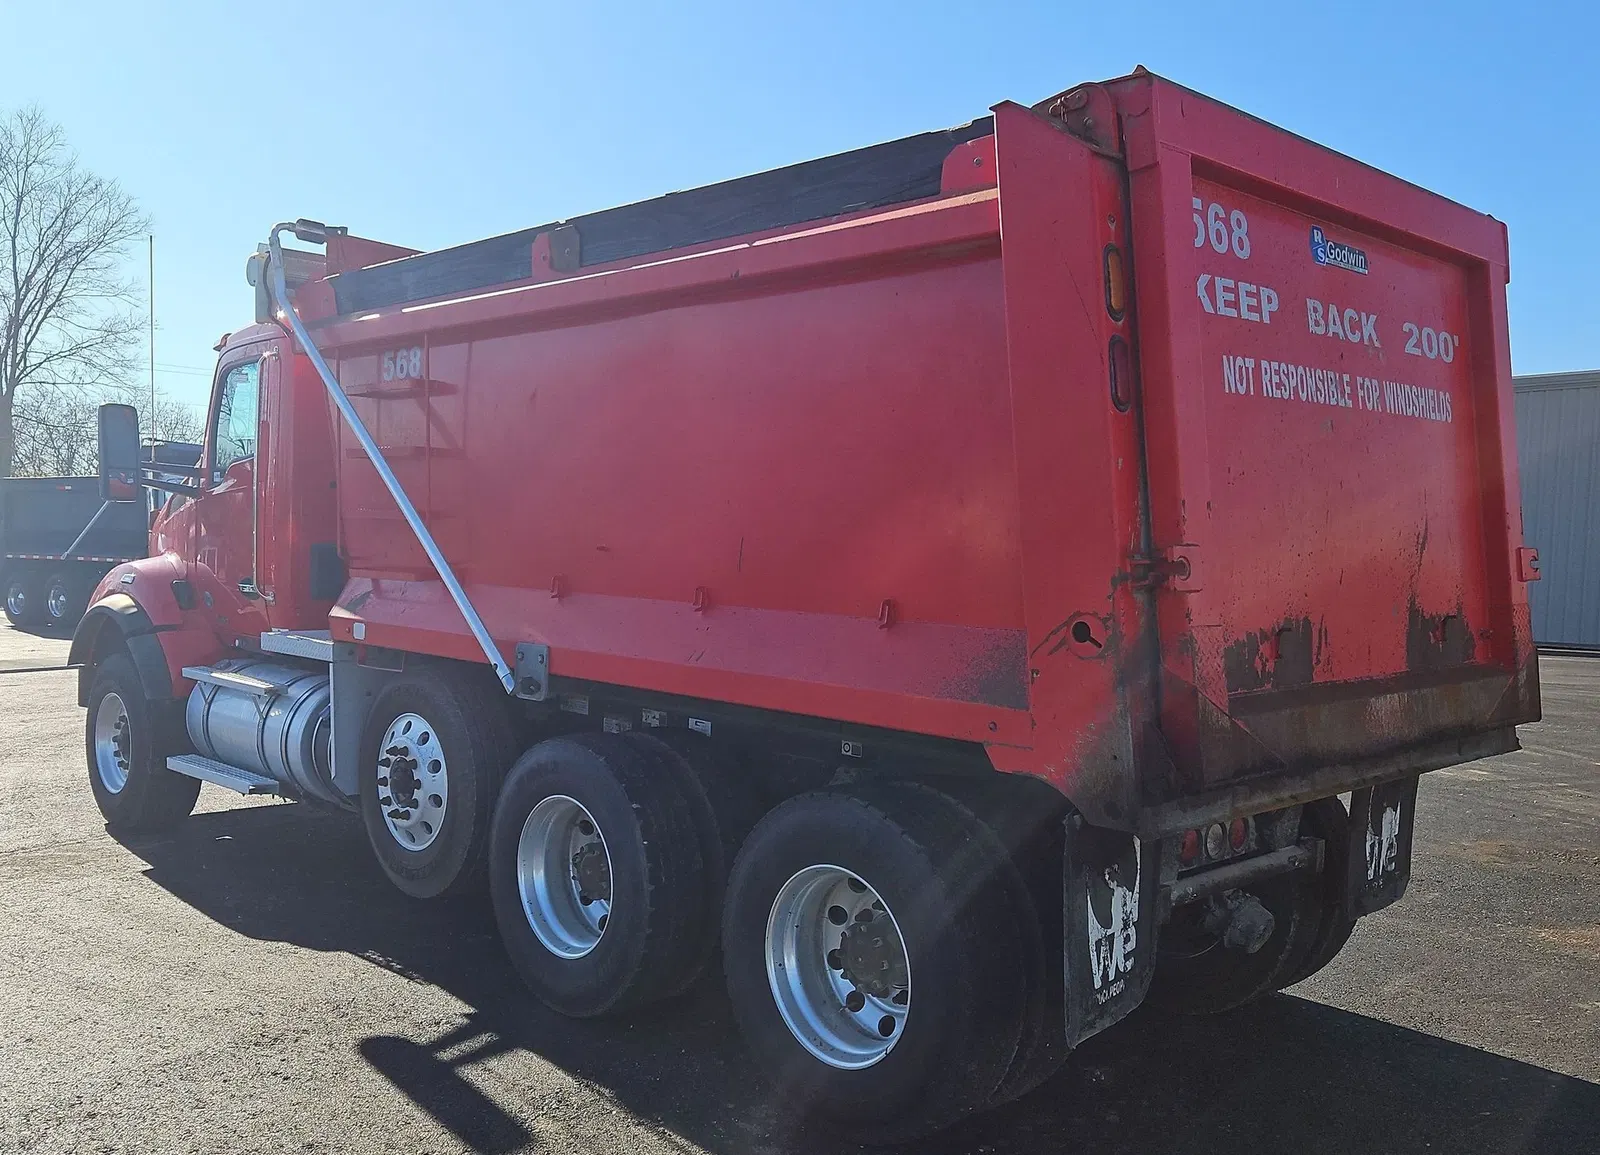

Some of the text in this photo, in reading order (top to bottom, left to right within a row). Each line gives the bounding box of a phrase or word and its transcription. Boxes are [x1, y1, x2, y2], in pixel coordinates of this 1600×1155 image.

[1192, 196, 1251, 259] 568
[1327, 241, 1365, 269] Godwin
[1196, 272, 1459, 363] KEEP BACK 200'
[383, 346, 421, 381] 568
[1222, 354, 1452, 423] NOT RESPONSIBLE FOR WINDSHIELDS
